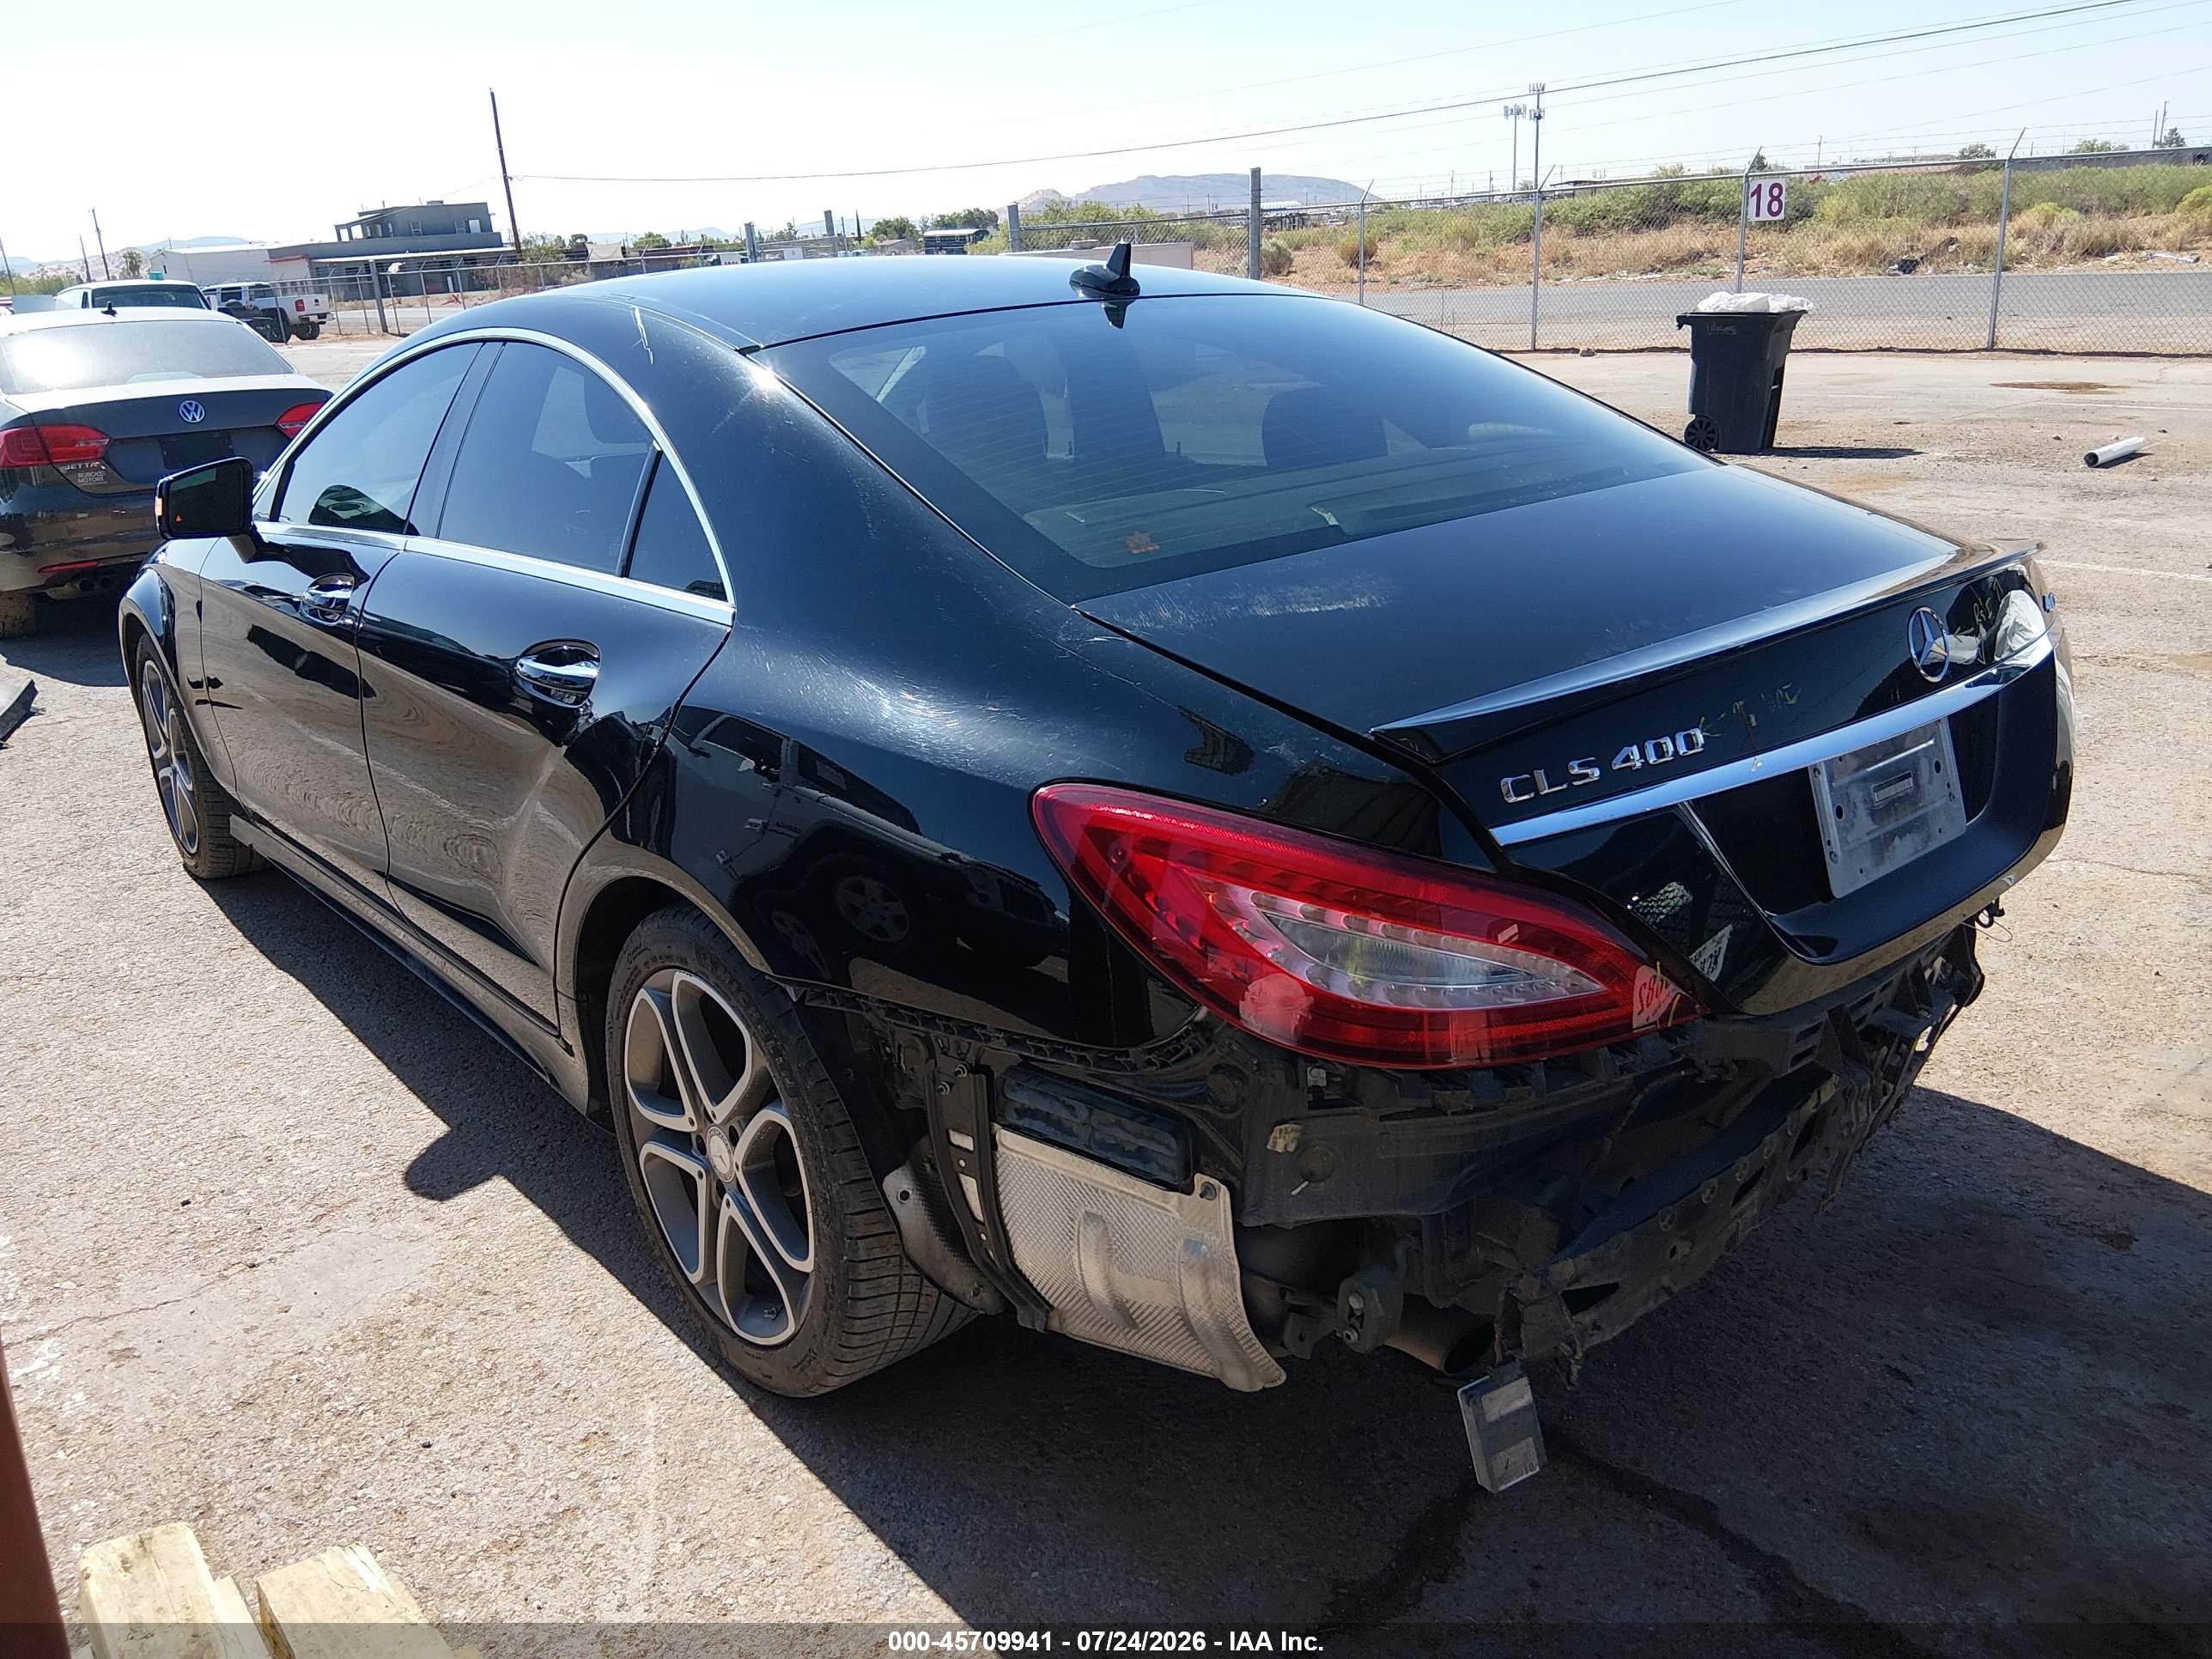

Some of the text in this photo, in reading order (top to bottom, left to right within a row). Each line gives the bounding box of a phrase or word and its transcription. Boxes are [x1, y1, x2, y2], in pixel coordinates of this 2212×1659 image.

[1751, 182, 1784, 218] 18
[1500, 727, 1705, 804] CLS 400
